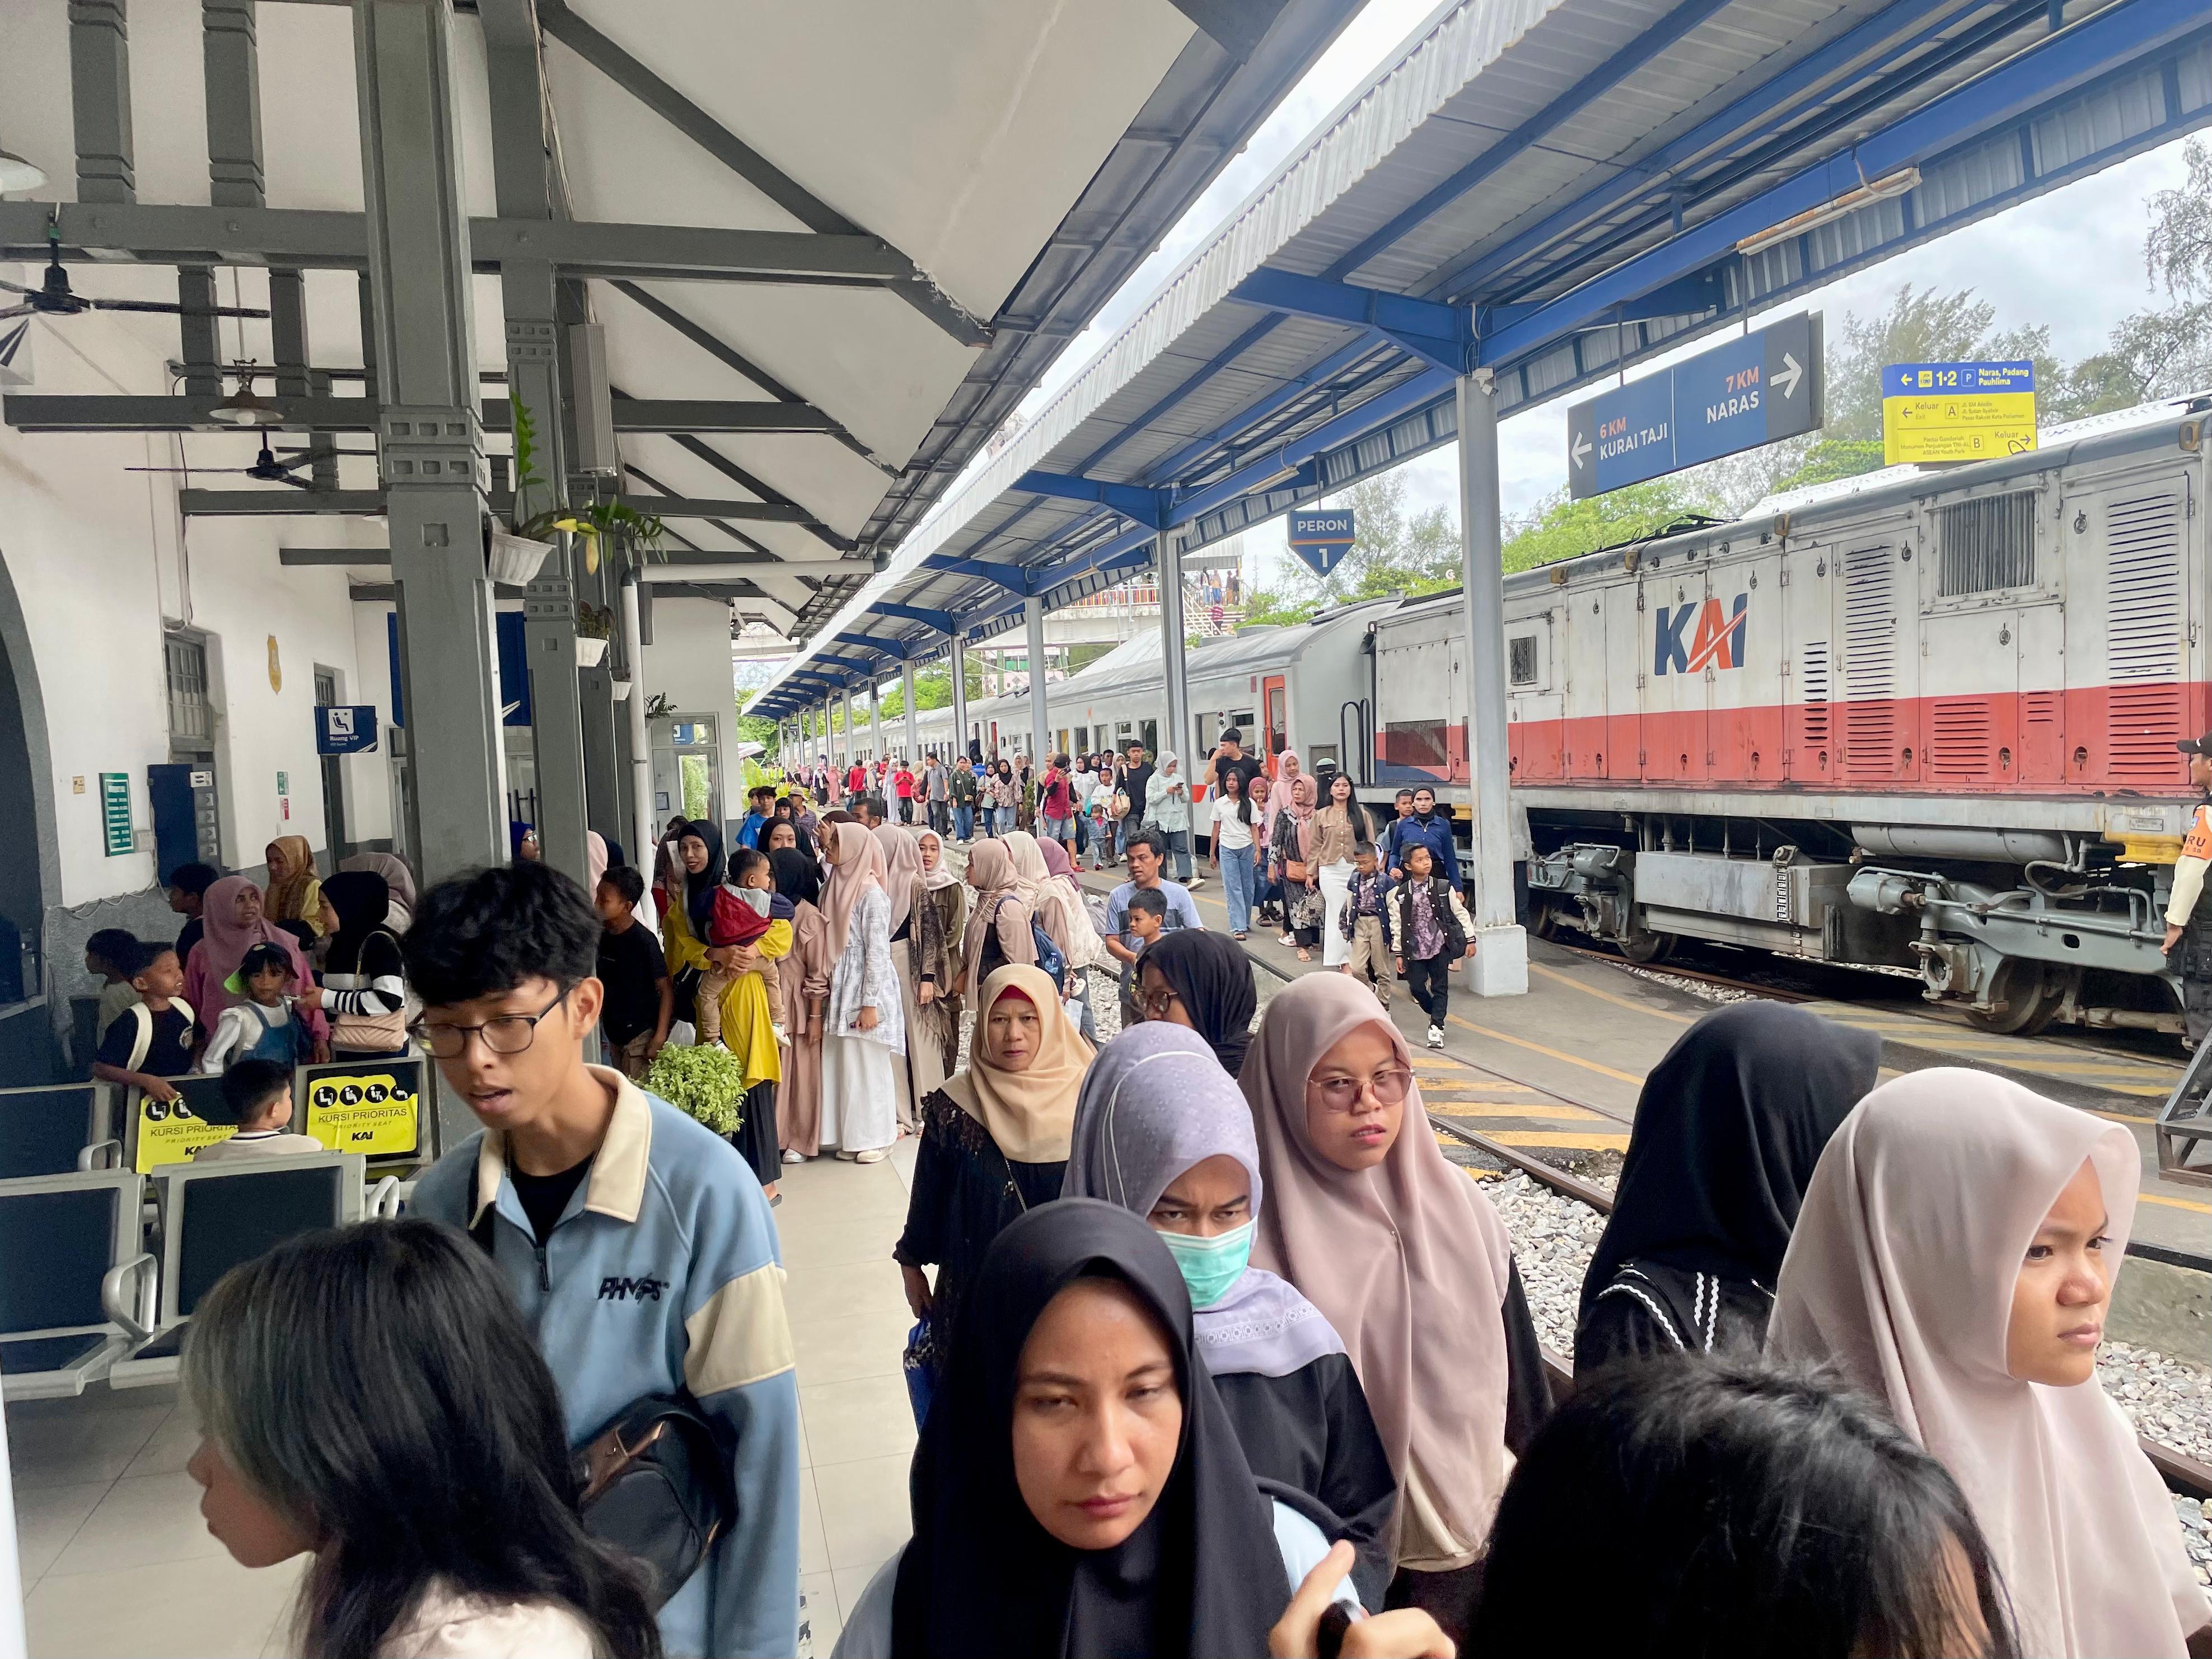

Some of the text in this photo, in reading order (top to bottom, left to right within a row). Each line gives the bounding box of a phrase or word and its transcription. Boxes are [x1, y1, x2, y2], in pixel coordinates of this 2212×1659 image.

[1979, 367, 2029, 377] Naras, Padang
[1725, 366, 1759, 393] 7 KM
[1707, 390, 1759, 423] NARAS
[1948, 406, 1956, 416] A
[1600, 417, 1626, 439] 6 KM
[1600, 422, 1668, 460] KURAI TAJI
[1974, 438, 1980, 448] B
[1297, 520, 1347, 532] PERON
[1318, 548, 1328, 568] 1
[1654, 592, 1748, 676] KAI
[318, 1108, 407, 1123] KURSI PRIORITAS
[151, 1127, 184, 1137] KURSI
[352, 1131, 373, 1141] KAI
[184, 1145, 207, 1156] KA
